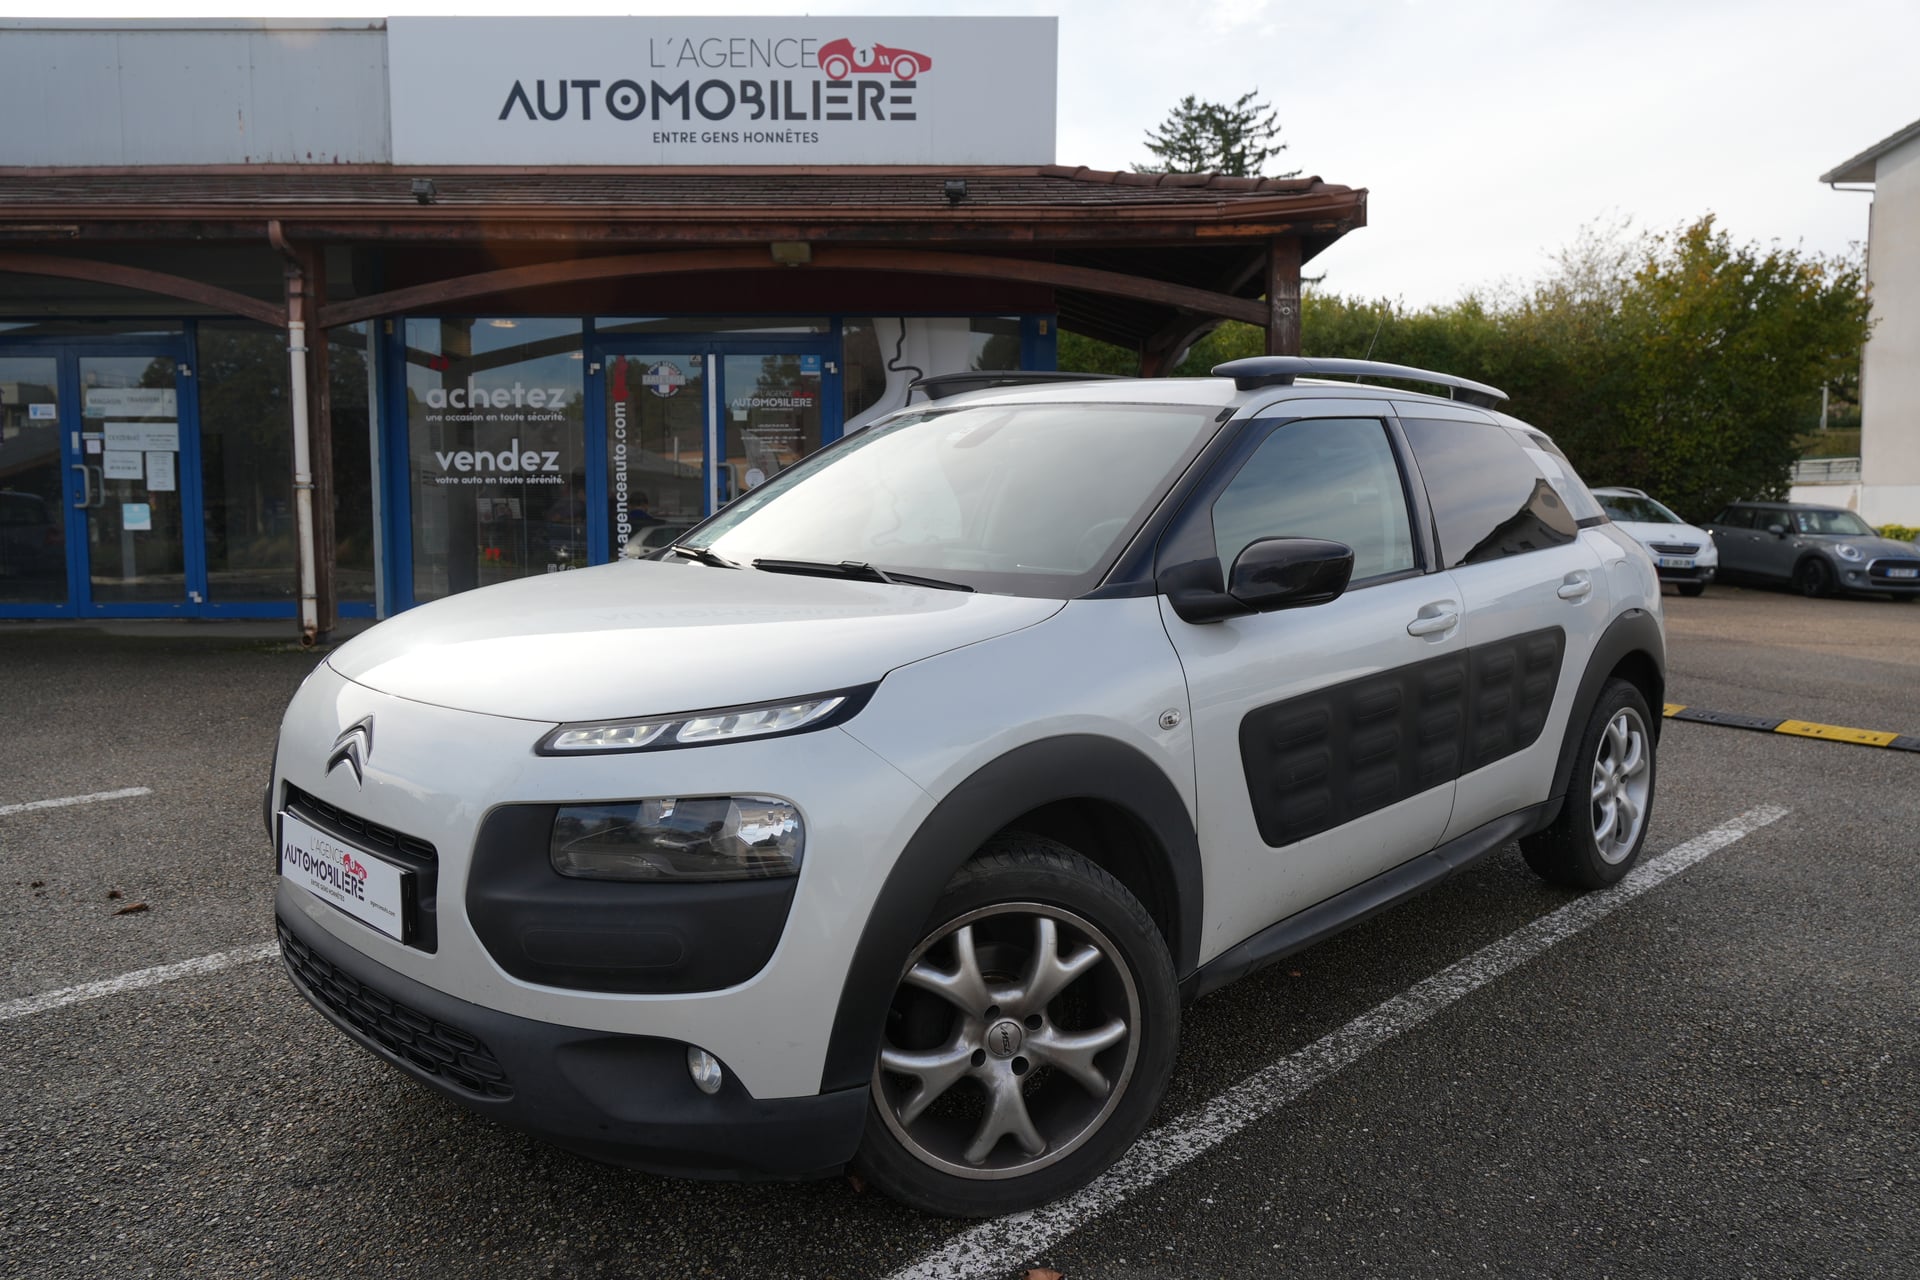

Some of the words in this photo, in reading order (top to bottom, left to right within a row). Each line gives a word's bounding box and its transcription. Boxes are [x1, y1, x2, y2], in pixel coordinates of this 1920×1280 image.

[649, 38, 818, 68] L'AGENCE
[498, 79, 917, 121] AUTOMOBILIERE
[652, 132, 697, 143] ENTRE
[701, 132, 739, 143] GENS
[743, 128, 819, 143] HONNÊTES
[426, 376, 566, 408] achetez
[732, 398, 812, 407] AUTOMOBILIERE
[445, 412, 483, 421] occasion
[500, 412, 524, 421] toute
[527, 411, 566, 421] sécurité.
[435, 438, 559, 471] vendez
[435, 475, 459, 484] votre
[461, 475, 482, 484] auto
[499, 474, 523, 484] toute
[526, 473, 565, 484] sérénité.
[613, 401, 632, 561] wagenceauto.com
[285, 844, 365, 901] AUTOMOBILIERE
